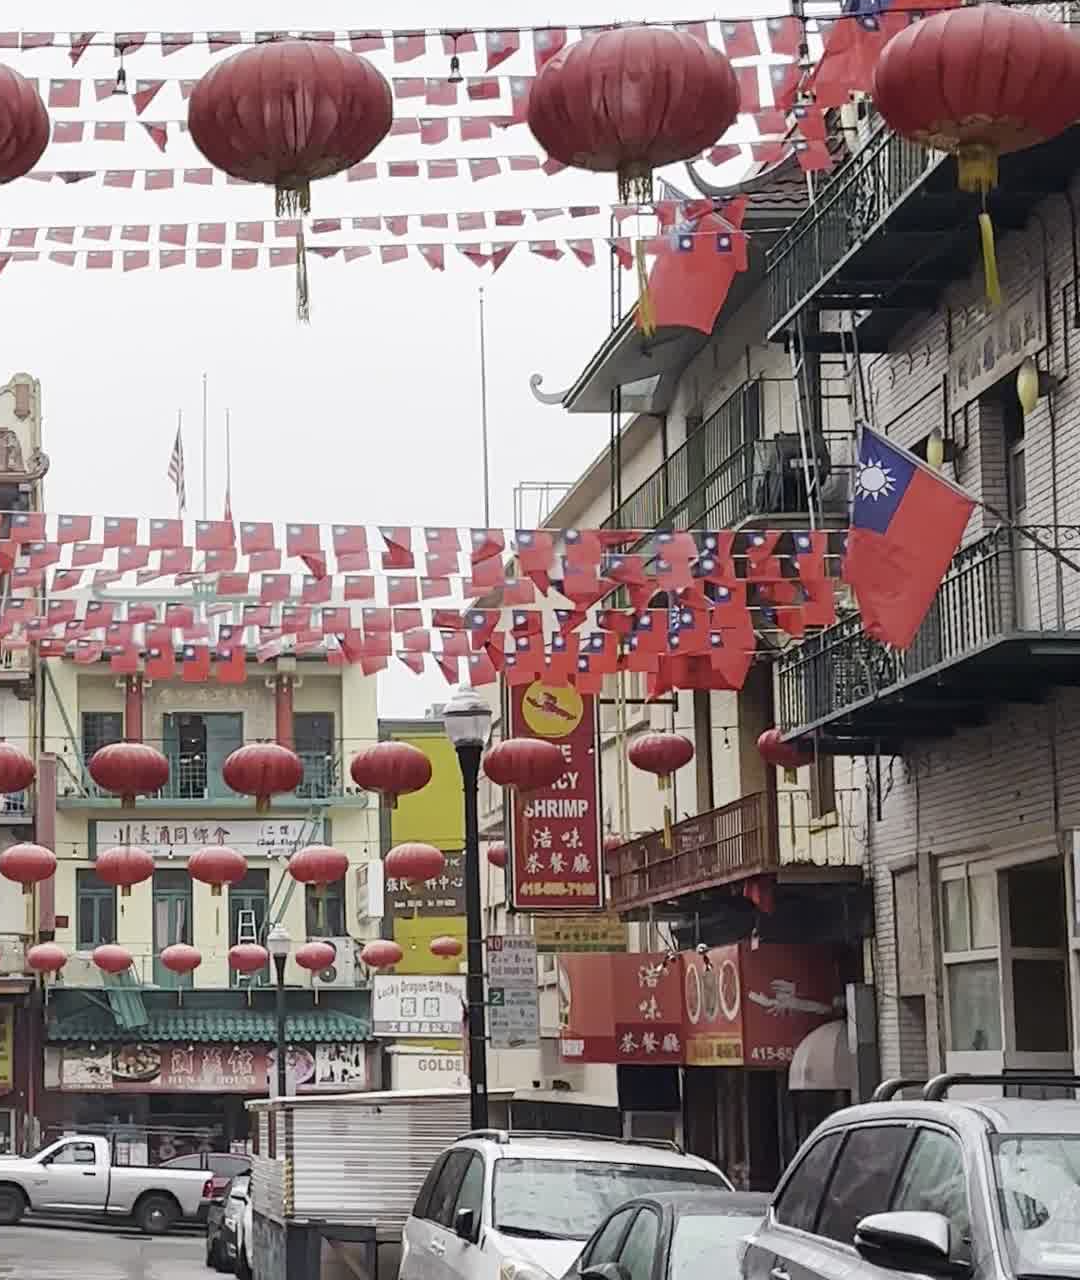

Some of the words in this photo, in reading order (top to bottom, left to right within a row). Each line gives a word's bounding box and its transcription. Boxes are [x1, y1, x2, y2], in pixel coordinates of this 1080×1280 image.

[523, 799, 590, 819] SHRIMP
[523, 853, 593, 875] 茶餐廳
[491, 992, 503, 1005] 2
[619, 1031, 681, 1055] 茶餐廳
